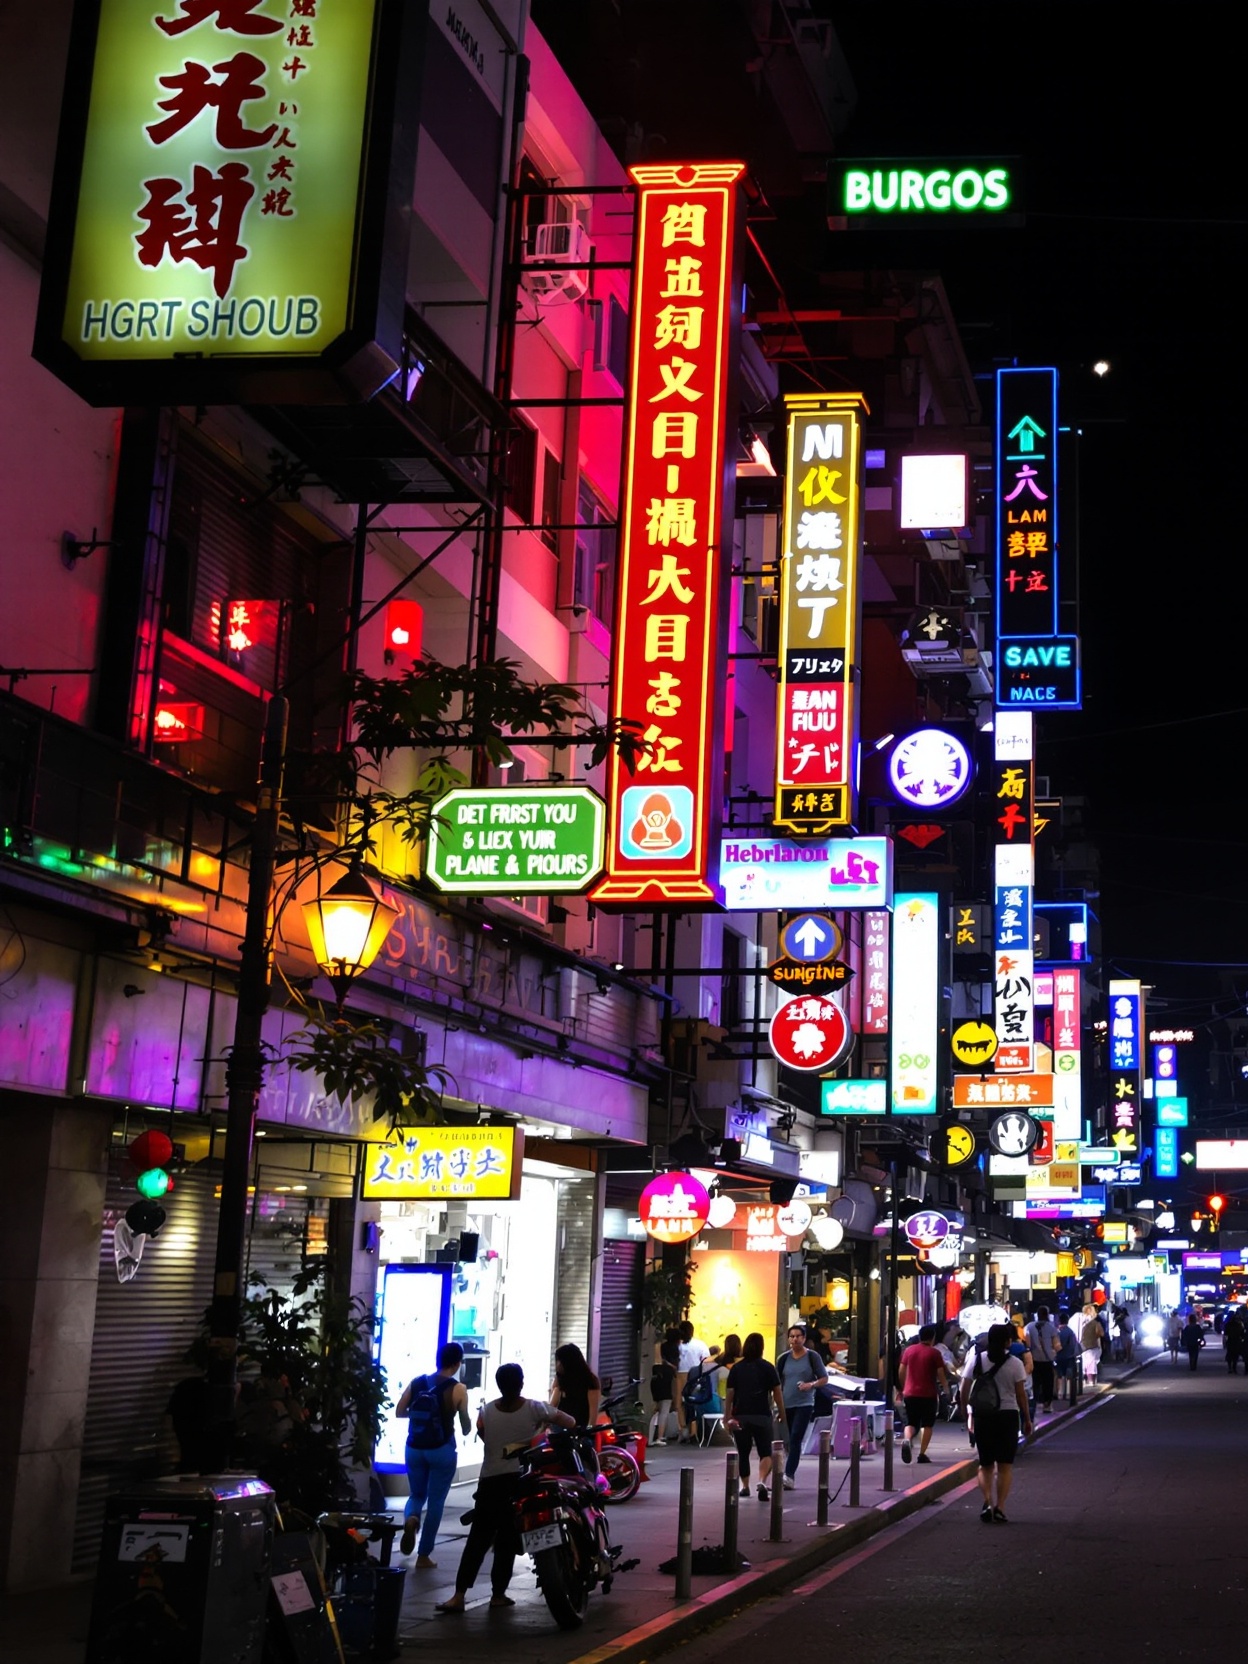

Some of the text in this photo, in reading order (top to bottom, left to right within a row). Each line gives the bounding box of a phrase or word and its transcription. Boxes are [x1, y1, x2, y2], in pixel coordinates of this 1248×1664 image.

[846, 169, 1009, 210] BURGOS
[83, 297, 319, 339] HGRT SHOUB
[1007, 508, 1047, 523] LAM
[1005, 646, 1071, 666] SAVE
[543, 803, 577, 824] YOU
[445, 855, 499, 875] PLANE
[505, 854, 519, 875] &
